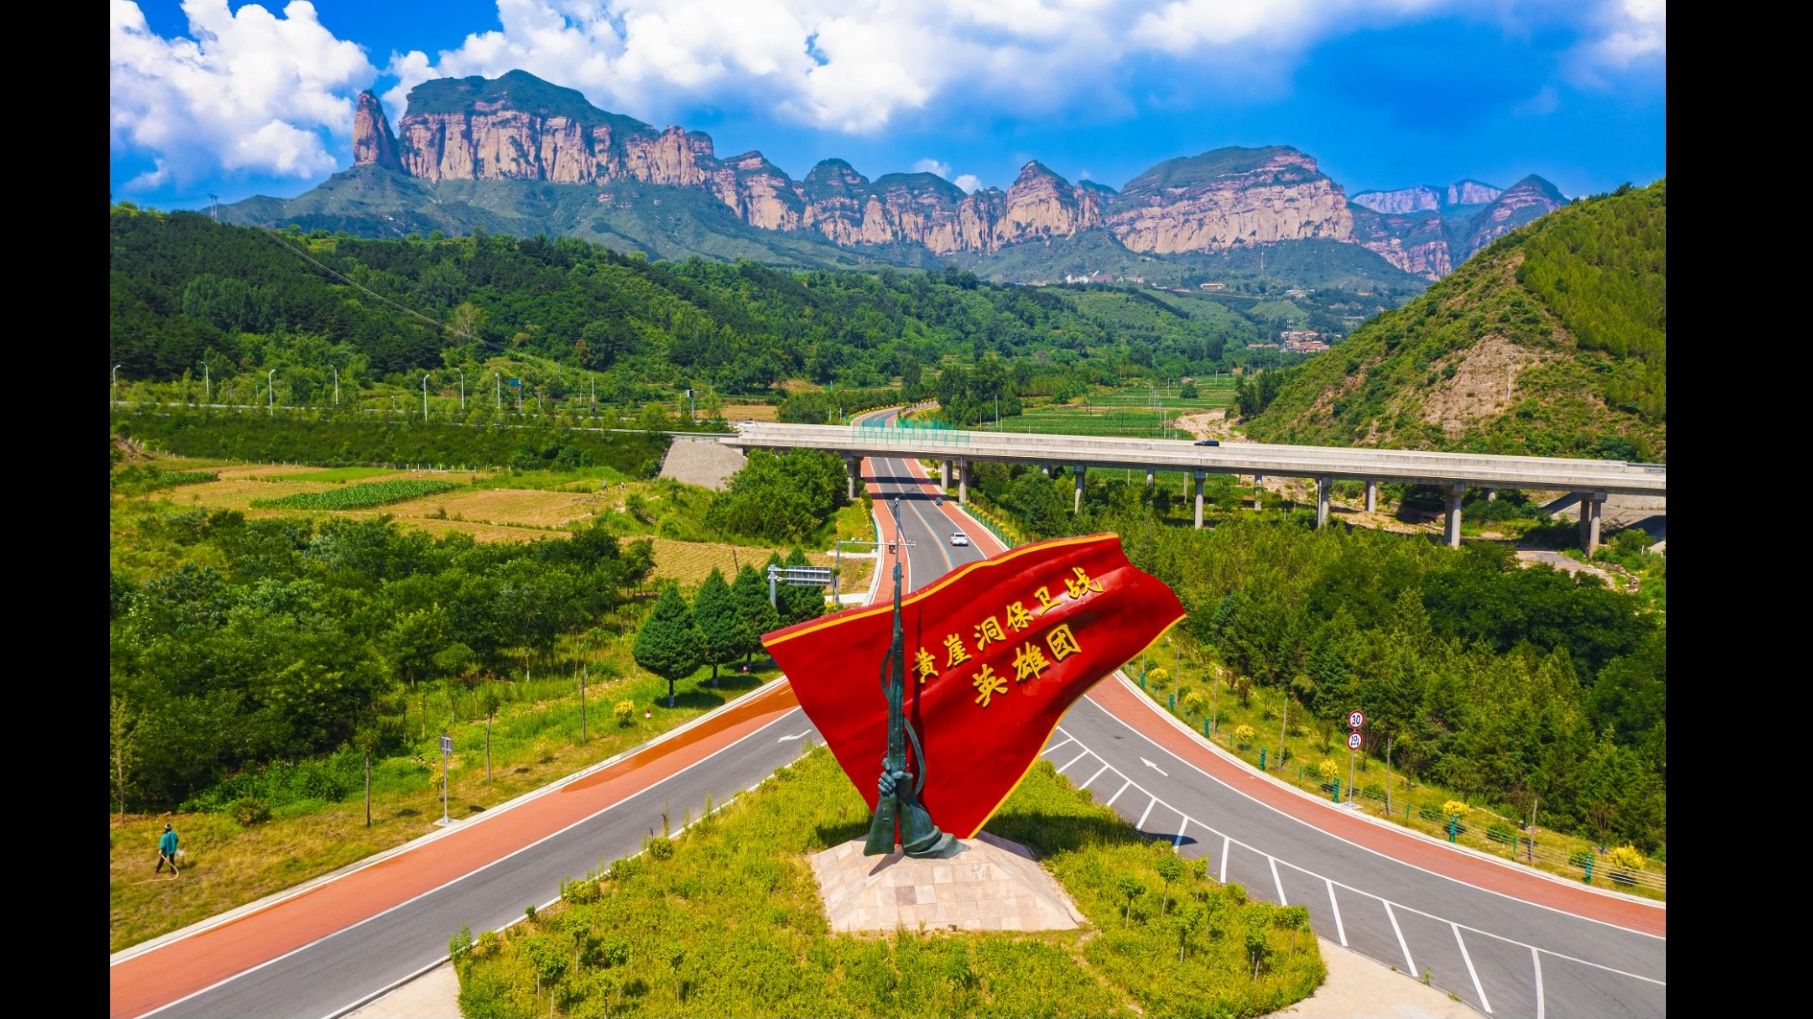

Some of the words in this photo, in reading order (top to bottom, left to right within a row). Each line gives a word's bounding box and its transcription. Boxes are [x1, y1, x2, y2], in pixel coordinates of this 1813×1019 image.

[912, 566, 1104, 684] 黄崖洞保卫战
[972, 624, 1082, 707] 英雄团
[1352, 715, 1361, 725] 30
